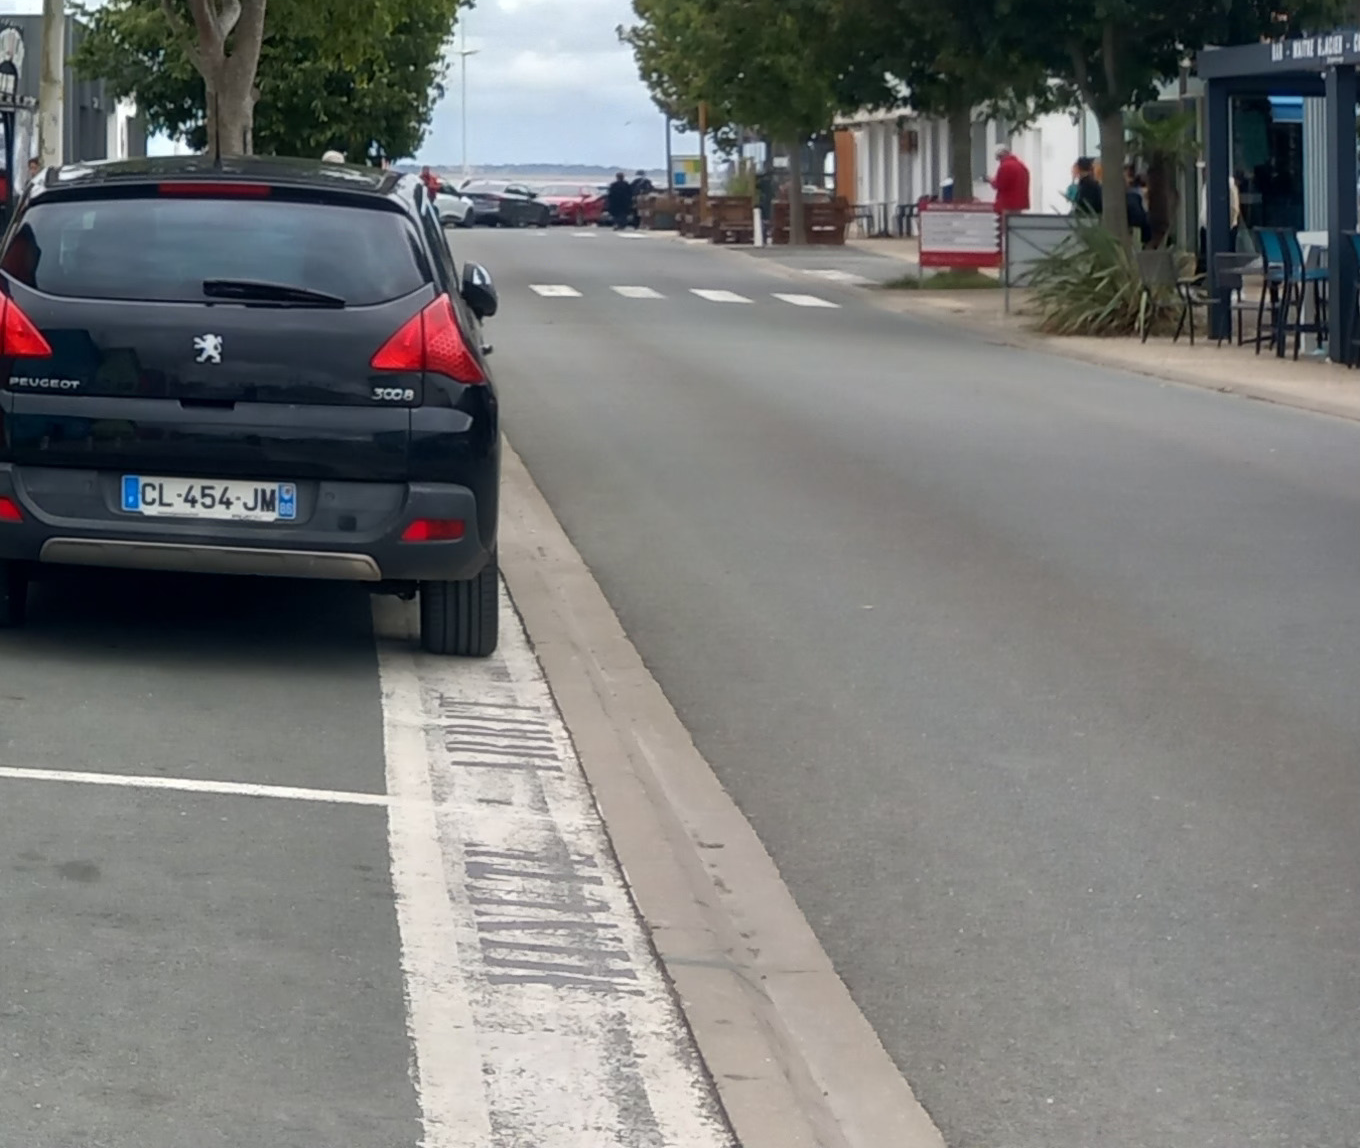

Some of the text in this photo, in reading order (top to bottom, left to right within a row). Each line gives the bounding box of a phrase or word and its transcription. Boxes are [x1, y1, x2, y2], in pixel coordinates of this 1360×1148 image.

[8, 376, 81, 390] PEUGEOT
[371, 387, 415, 402] 3008
[141, 482, 276, 513] CL-454-JM
